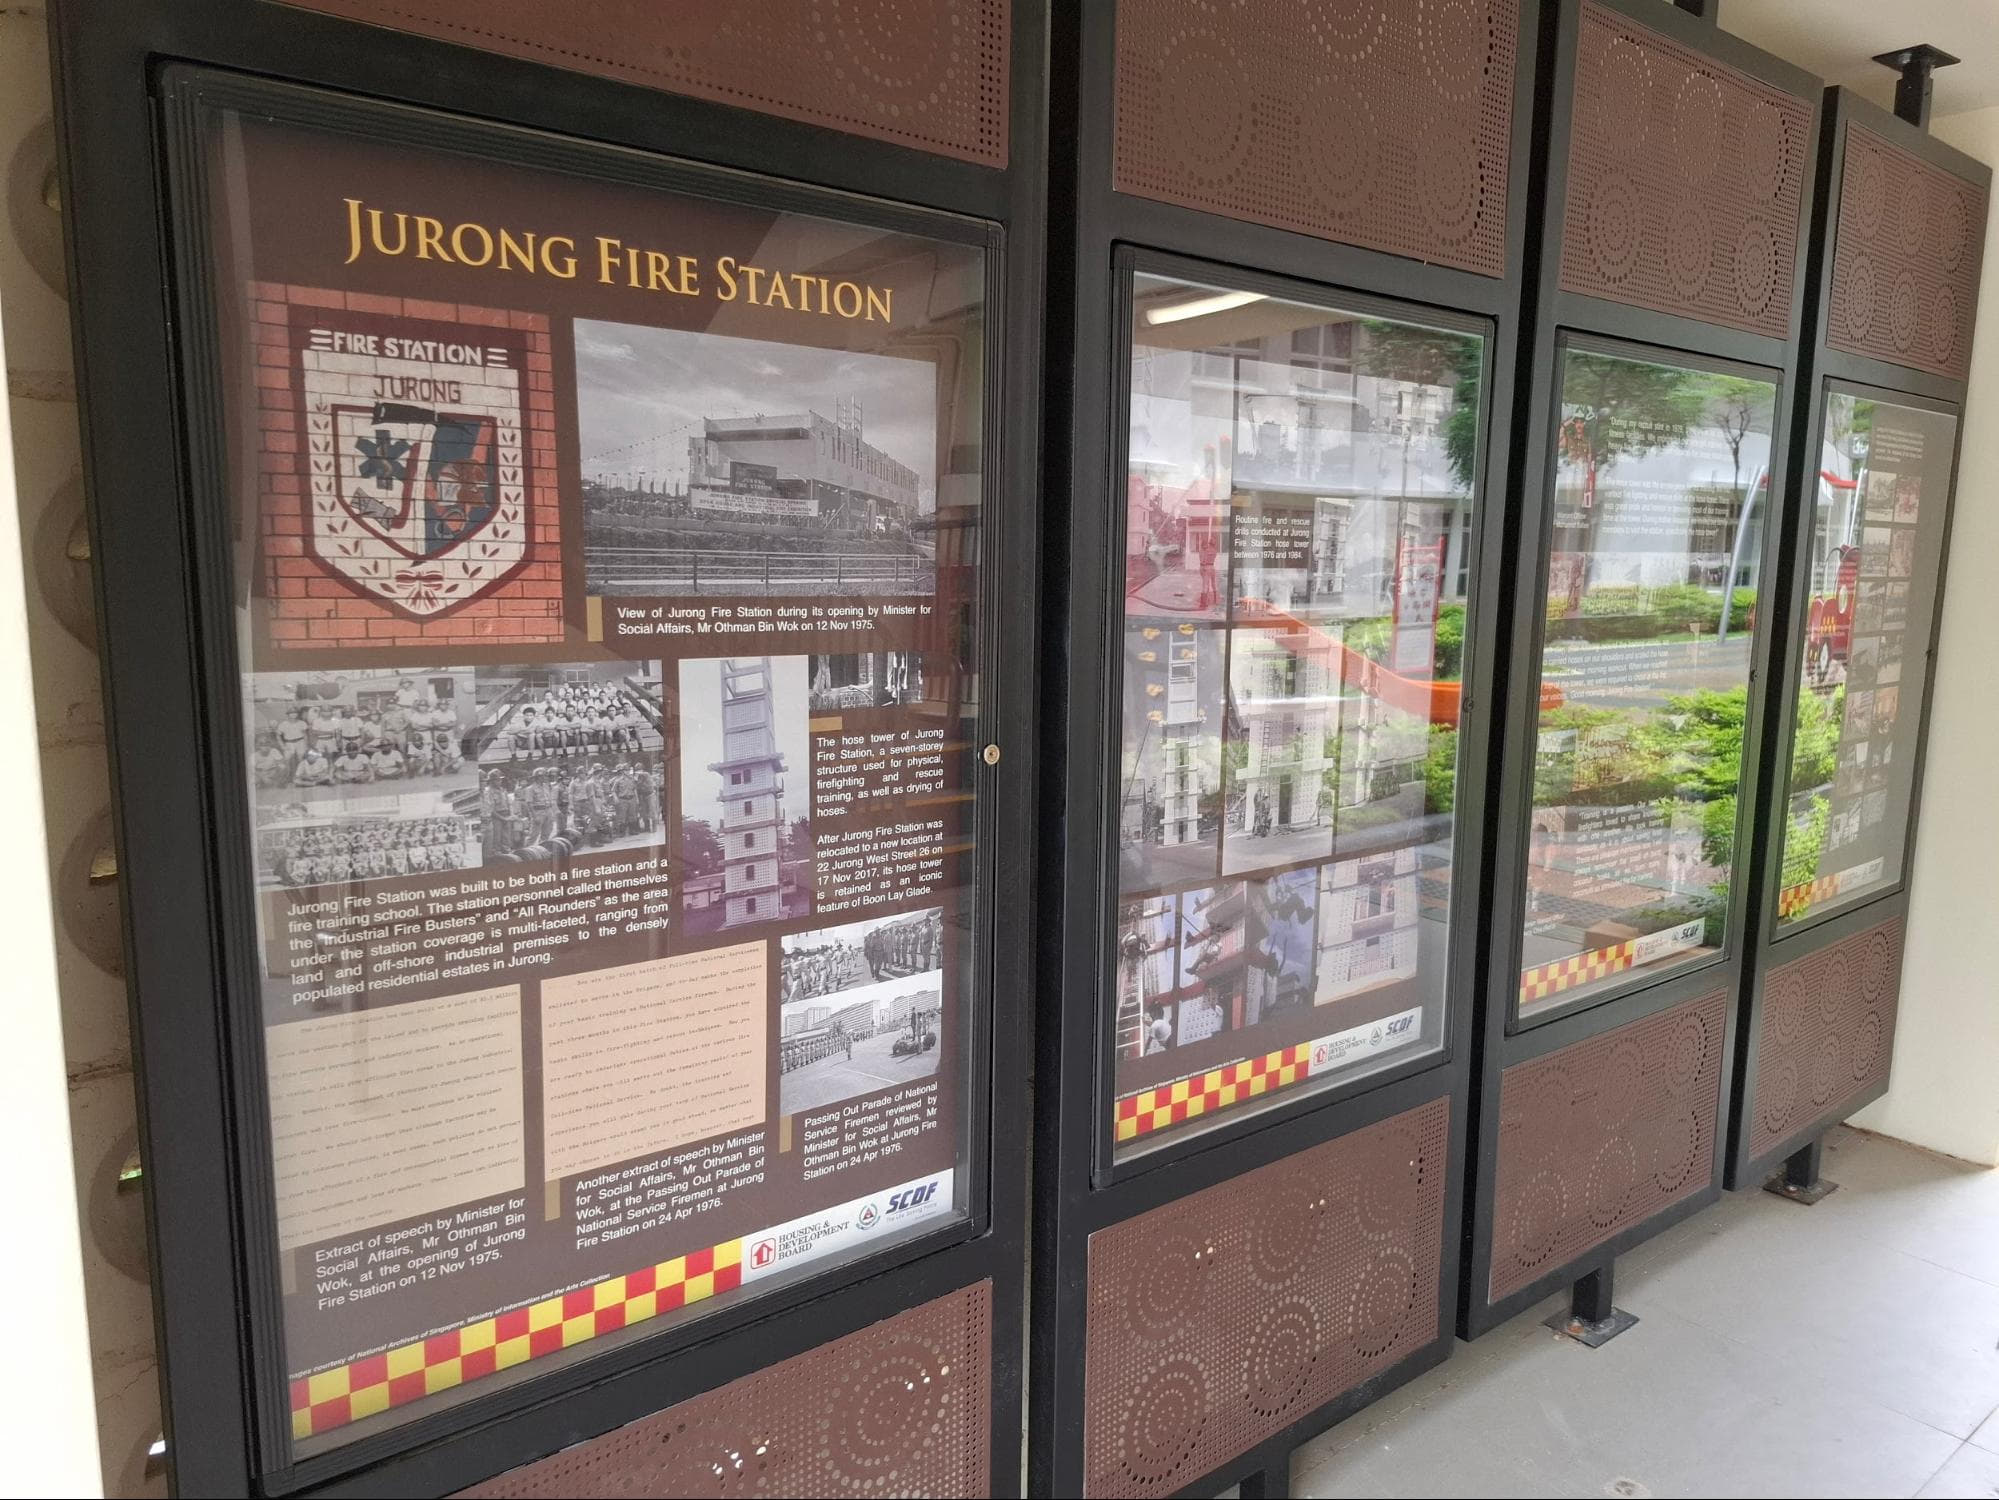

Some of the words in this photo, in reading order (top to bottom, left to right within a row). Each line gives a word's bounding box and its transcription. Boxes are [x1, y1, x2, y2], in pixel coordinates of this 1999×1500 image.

[344, 199, 577, 278] JURONG
[595, 237, 699, 296] FIRE
[717, 257, 892, 323] STATION
[334, 332, 378, 355] FIRE
[384, 338, 482, 365] STATION
[374, 375, 461, 402] JURONG
[1235, 516, 1257, 524] Routine
[618, 609, 645, 618] View
[651, 608, 662, 617] of
[668, 608, 705, 619] Jurong
[712, 608, 731, 616] Fire
[737, 607, 771, 616] Station
[777, 607, 807, 618] during
[812, 606, 822, 615] its
[827, 606, 863, 617] opening
[868, 606, 878, 617] by
[883, 605, 915, 614] Minister
[920, 605, 931, 614] for
[618, 624, 652, 634] Social
[656, 623, 694, 633] Affairs,
[697, 623, 711, 632] Mr
[714, 622, 755, 631] Othman
[758, 621, 774, 631] Bin
[777, 621, 798, 630] Wok
[816, 620, 827, 629] 12
[830, 620, 847, 629] Nov
[851, 619, 874, 629] 1975.
[817, 737, 835, 746] The
[842, 735, 863, 744] hose
[871, 733, 894, 742] tower
[901, 731, 908, 739] of
[915, 730, 943, 739] Jurong
[817, 751, 835, 760] Fire
[840, 748, 874, 758] Station,
[890, 742, 943, 753] seven-storey
[817, 776, 864, 789] firefighting
[882, 772, 898, 781] and
[915, 769, 942, 777] rescue
[817, 807, 847, 817] hoses.
[817, 834, 838, 844] After
[841, 830, 872, 841] Jurong
[876, 826, 892, 836] Fire
[895, 822, 923, 833] Station
[927, 820, 942, 828] was
[817, 861, 828, 872] 22
[832, 858, 863, 869] Jurong
[866, 852, 888, 864] West
[891, 847, 916, 860] Street
[919, 845, 929, 855] 26
[932, 845, 942, 853] on
[287, 901, 338, 916] Jurong
[344, 896, 371, 908] Fire
[376, 889, 424, 904] Station
[429, 886, 456, 897] was
[461, 880, 487, 893] built
[492, 878, 504, 889] to
[508, 876, 524, 886] be
[529, 871, 555, 884] both
[560, 872, 567, 880] a
[571, 868, 589, 878] fire
[594, 863, 631, 875] station
[636, 859, 656, 869] and
[817, 901, 848, 913] feature
[851, 896, 859, 906] of
[863, 894, 885, 904] Boon
[888, 890, 903, 901] Lay
[906, 885, 932, 897] Glade.
[288, 921, 312, 933] fire
[316, 913, 369, 929] training
[373, 906, 421, 921] school.
[427, 902, 452, 914] The
[456, 896, 499, 910] station
[503, 886, 563, 906] personnel
[567, 881, 601, 894] called
[604, 874, 667, 889] themselves
[290, 953, 333, 968] under
[340, 948, 363, 960] the
[370, 941, 416, 955] station
[423, 931, 484, 947] coverage
[491, 927, 501, 937] is
[508, 914, 589, 934] multi-faceted,
[595, 908, 637, 921] ranging
[643, 904, 667, 913] from
[292, 981, 363, 1006] populated
[368, 969, 437, 990] residential
[442, 963, 489, 978] estates
[493, 959, 504, 969] in
[508, 953, 554, 967] Jurong.
[1385, 1015, 1414, 1036] SCDF
[804, 1111, 839, 1128] Passing
[843, 1103, 858, 1117] Out
[862, 1095, 891, 1111] Parade
[895, 1091, 902, 1101] of
[905, 1080, 937, 1098] National
[804, 1125, 837, 1141] Service
[844, 1112, 879, 1129] Firemen
[885, 1098, 920, 1116] reviewed
[927, 1094, 936, 1105] by
[576, 1212, 621, 1235] National
[627, 1202, 666, 1220] Service
[671, 1188, 712, 1206] Firemen
[717, 1181, 726, 1193] at
[731, 1173, 763, 1189] Jurong
[885, 1181, 938, 1214] SCDF
[315, 1239, 363, 1262] Extract
[368, 1234, 380, 1248] of
[385, 1220, 432, 1244] speech
[437, 1217, 452, 1230] by
[456, 1203, 504, 1224] Minister
[509, 1198, 524, 1210] for
[577, 1236, 597, 1249] Fire
[601, 1224, 639, 1241] Station
[642, 1219, 655, 1229] on
[658, 1211, 671, 1224] 24
[674, 1208, 692, 1220] Apr
[696, 1197, 723, 1212] 1976.
[778, 1221, 850, 1251] DEVELOPMENT
[779, 1222, 821, 1243] HOUSING
[823, 1220, 830, 1229] &
[778, 1242, 812, 1260] BOARD
[318, 1295, 345, 1310] Fire
[349, 1281, 395, 1301] Station
[399, 1275, 415, 1286] on
[420, 1266, 436, 1280] 12
[440, 1261, 464, 1275] Nov
[470, 1249, 502, 1266] 1975.
